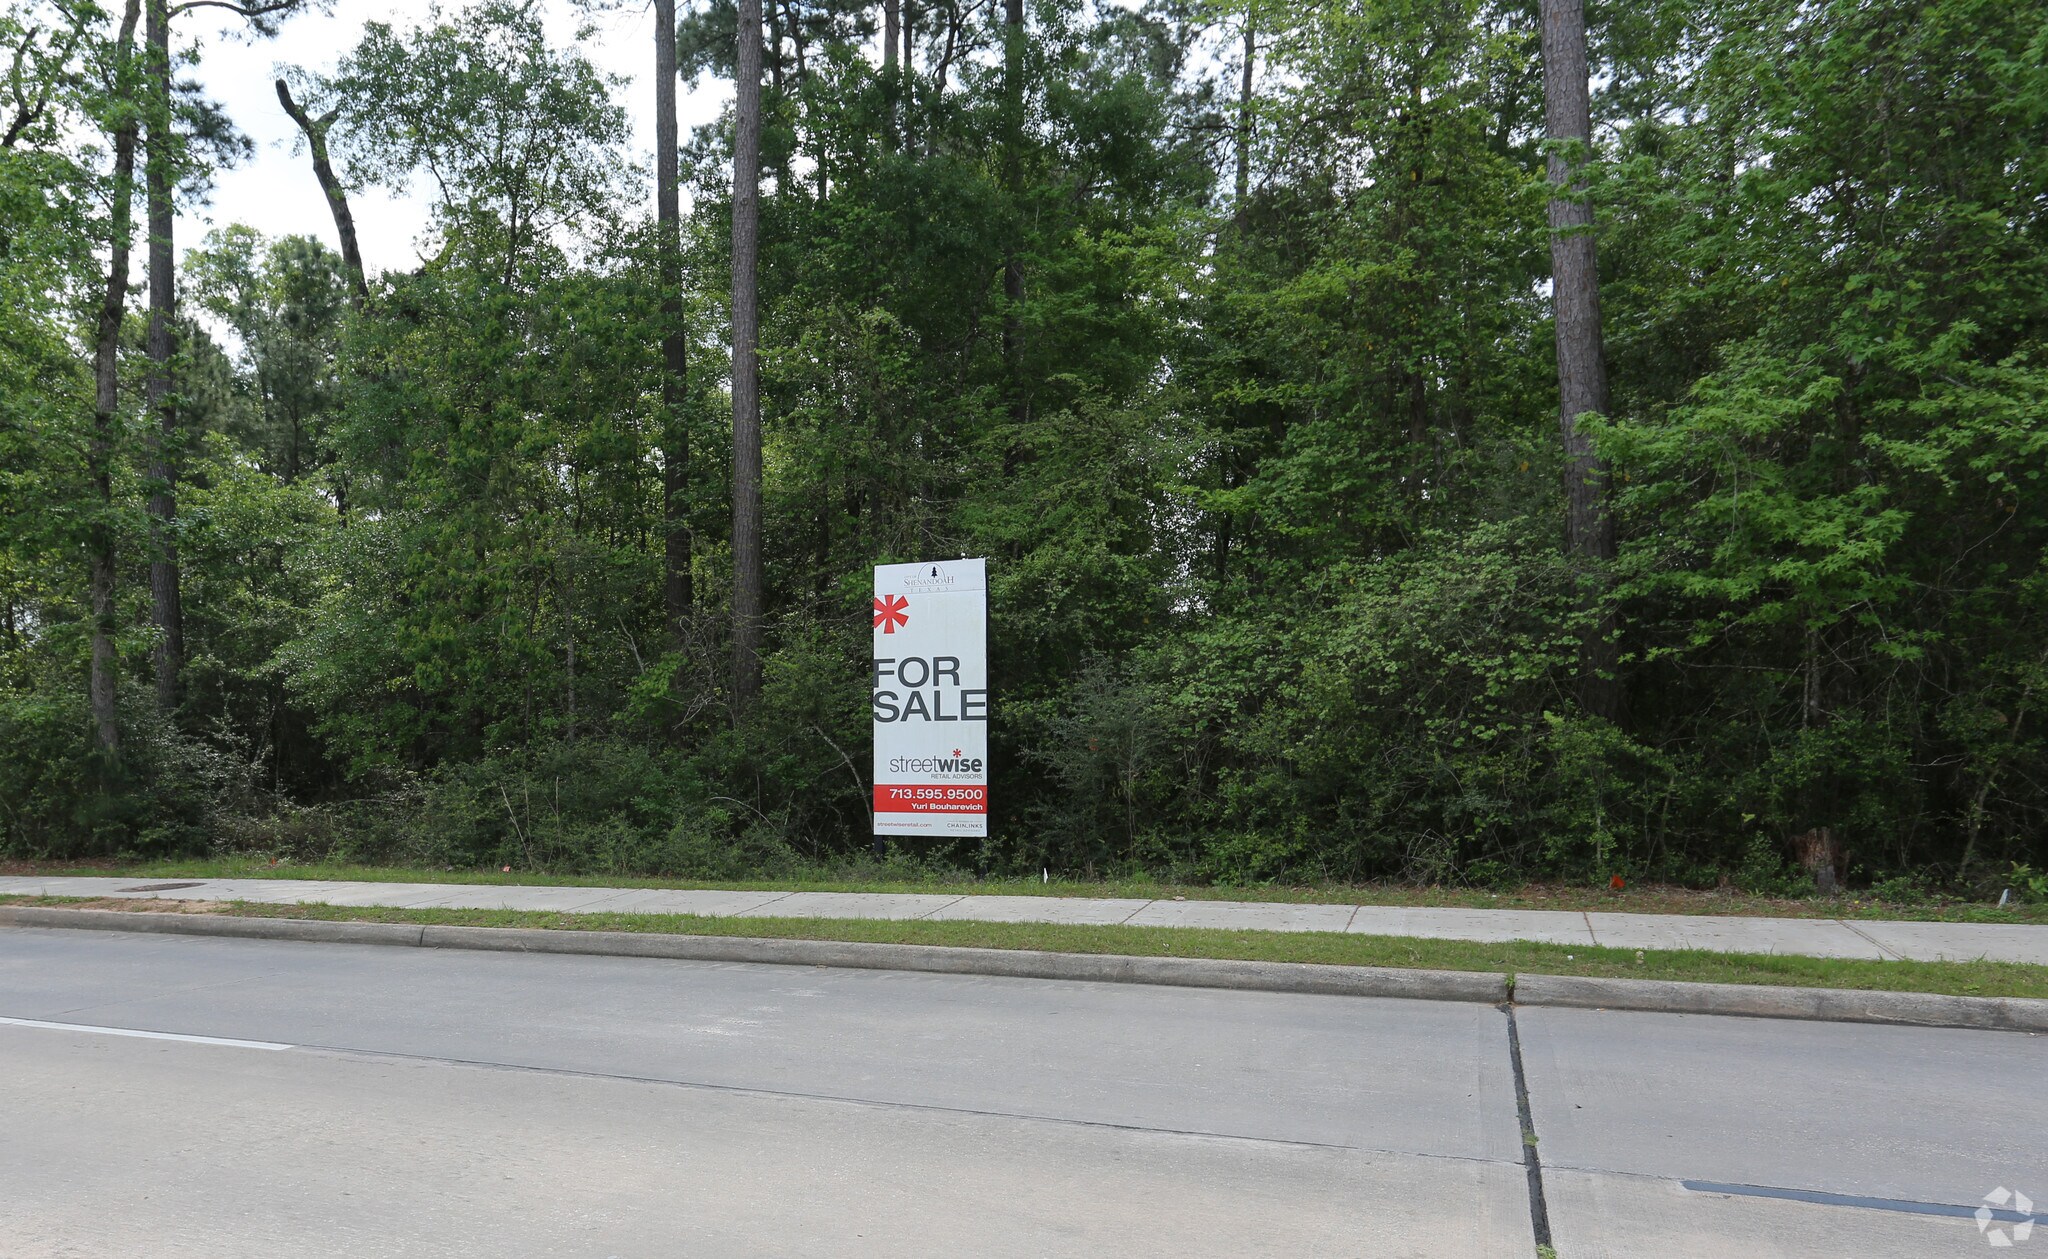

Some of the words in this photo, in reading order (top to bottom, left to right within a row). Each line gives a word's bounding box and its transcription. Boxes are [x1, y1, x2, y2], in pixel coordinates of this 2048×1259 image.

[904, 576, 954, 587] SHENANDOAH
[873, 656, 960, 688] FOR
[873, 689, 987, 723] SALE
[889, 754, 983, 773] streetwise
[889, 788, 983, 800] 713.595.9500
[930, 803, 983, 811] Bouharevich
